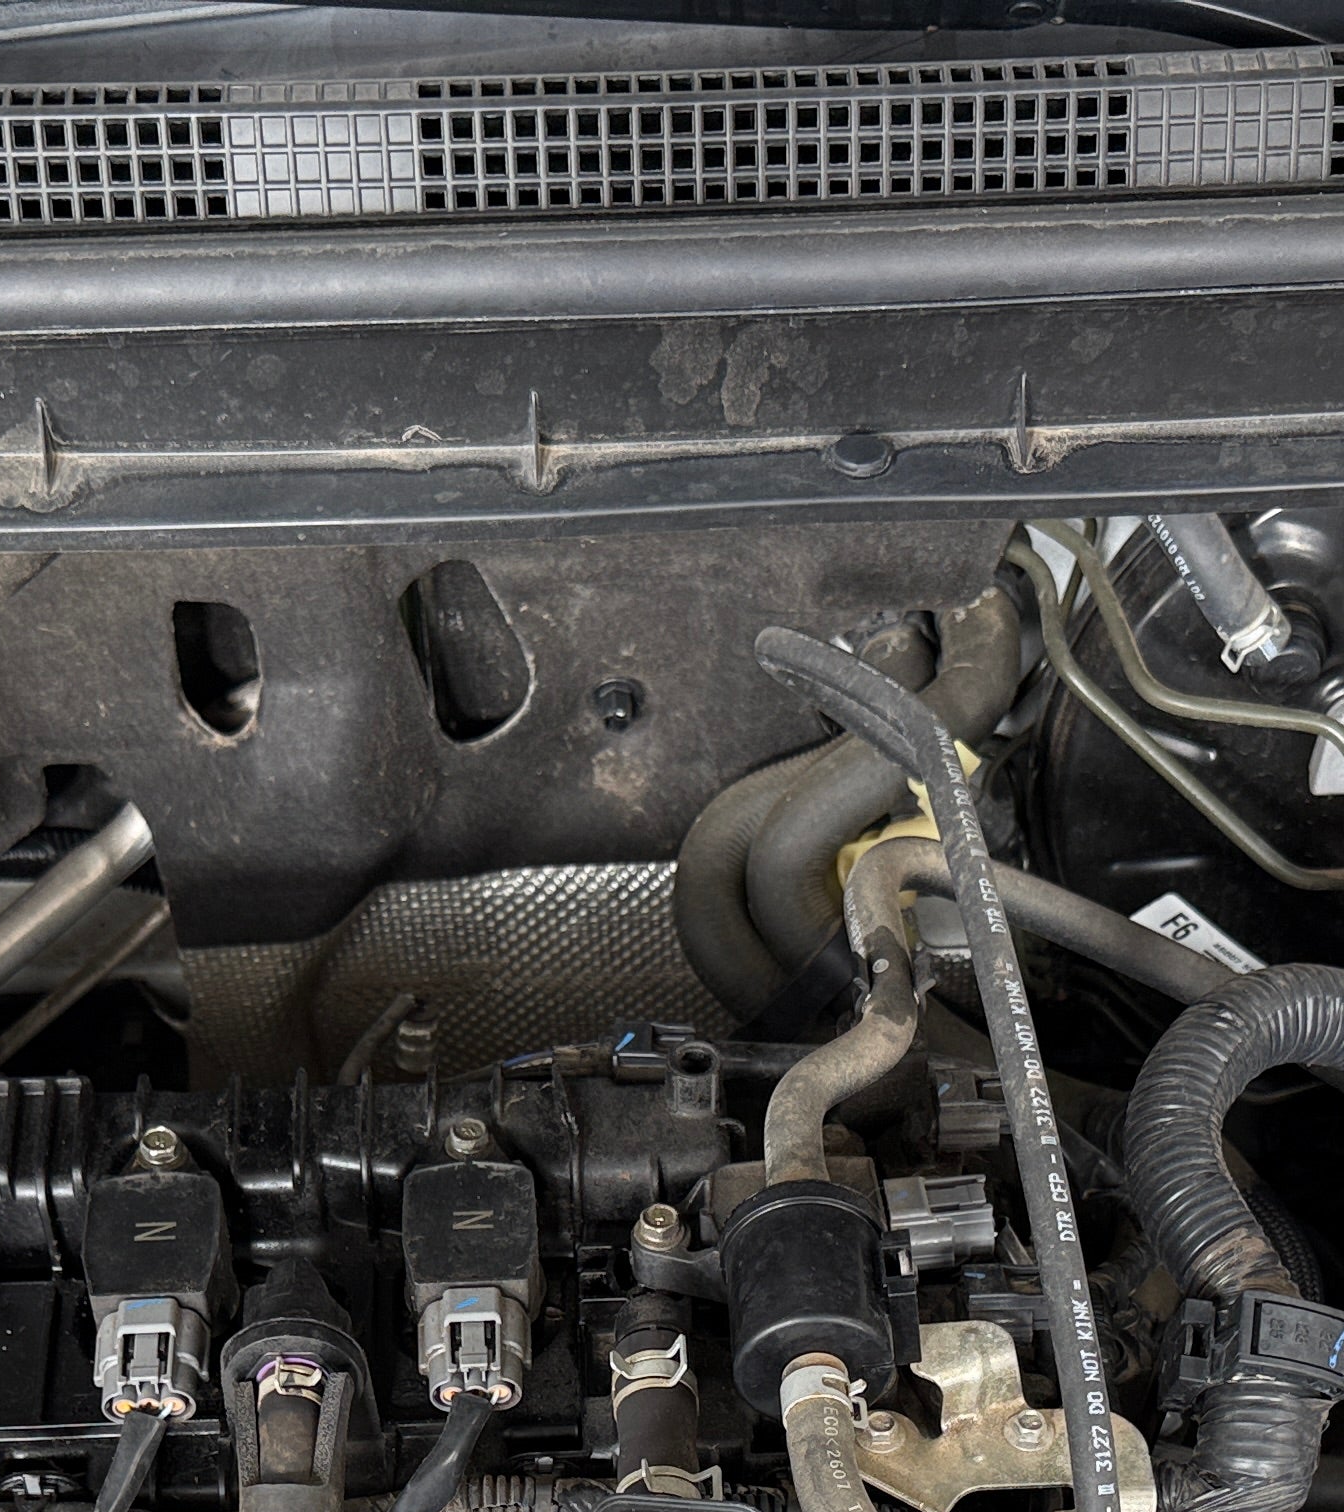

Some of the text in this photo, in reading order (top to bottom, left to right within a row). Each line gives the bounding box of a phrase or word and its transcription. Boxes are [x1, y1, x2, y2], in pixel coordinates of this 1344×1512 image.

[1159, 912, 1200, 942] F6
[1003, 978, 1028, 1016] KINK
[1014, 1021, 1037, 1053] NOT
[1023, 1057, 1045, 1081] DO
[1029, 1086, 1055, 1130] 3127
[1055, 1209, 1077, 1243] DTR
[1070, 1297, 1095, 1344] KINK
[1078, 1348, 1102, 1383] NOT
[1087, 1390, 1106, 1417] DO
[1092, 1424, 1114, 1474] 3127
